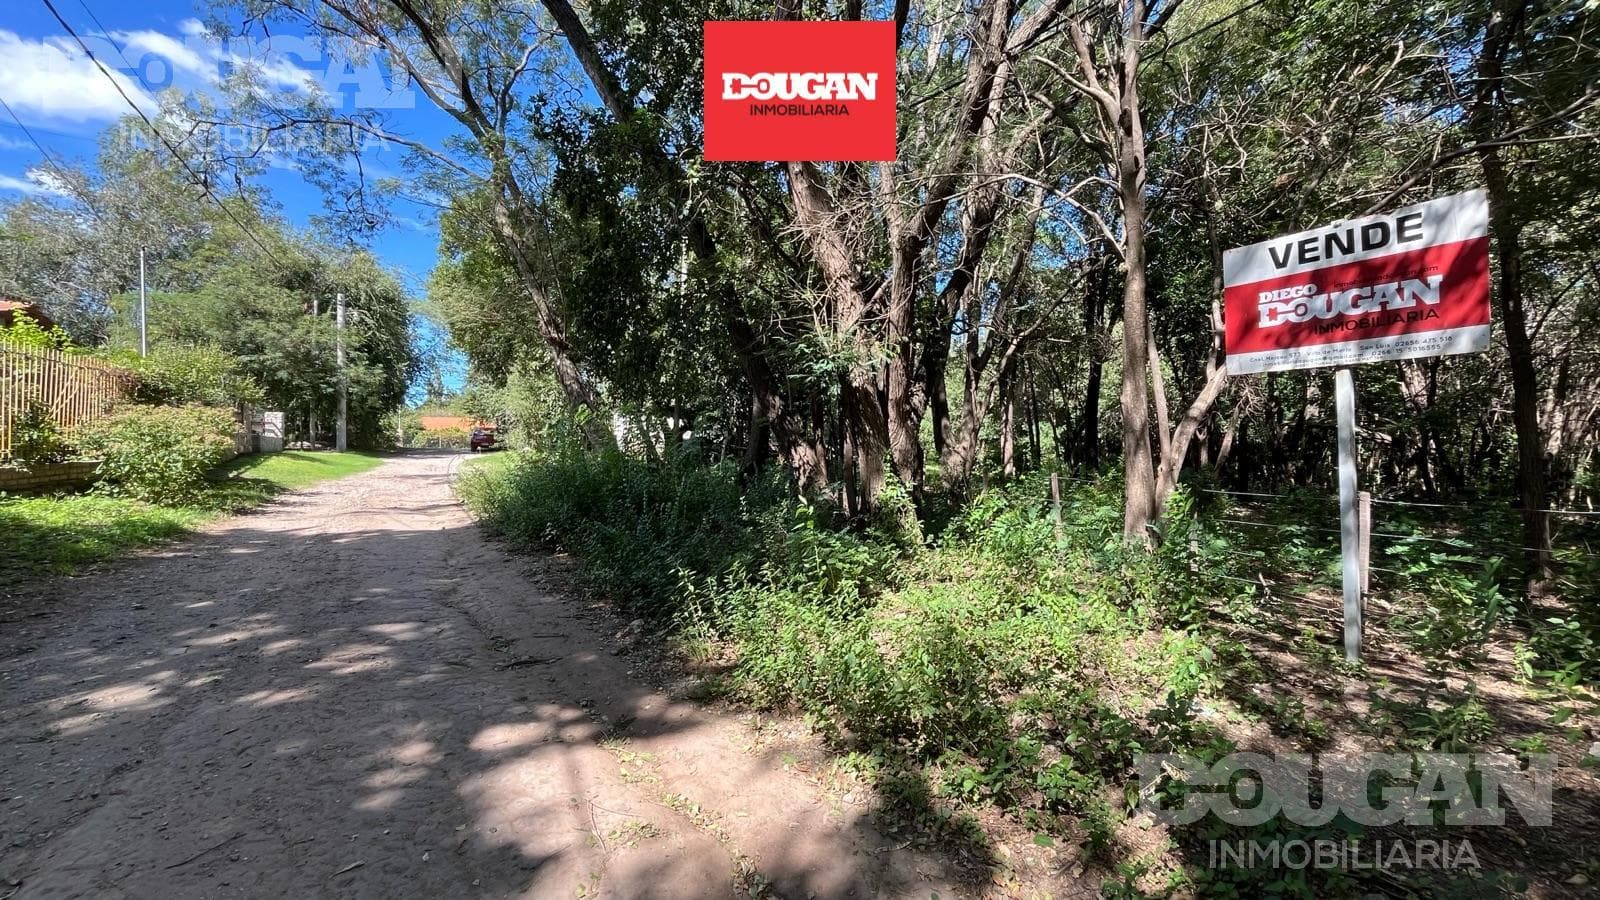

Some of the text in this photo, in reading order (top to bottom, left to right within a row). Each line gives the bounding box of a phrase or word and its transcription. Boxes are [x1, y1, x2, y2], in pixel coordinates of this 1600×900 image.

[1267, 212, 1424, 270] VENDE
[1258, 283, 1318, 302] DIEGO
[1258, 275, 1443, 328] DOUGAN
[1313, 308, 1440, 335] INMOBILIARIA
